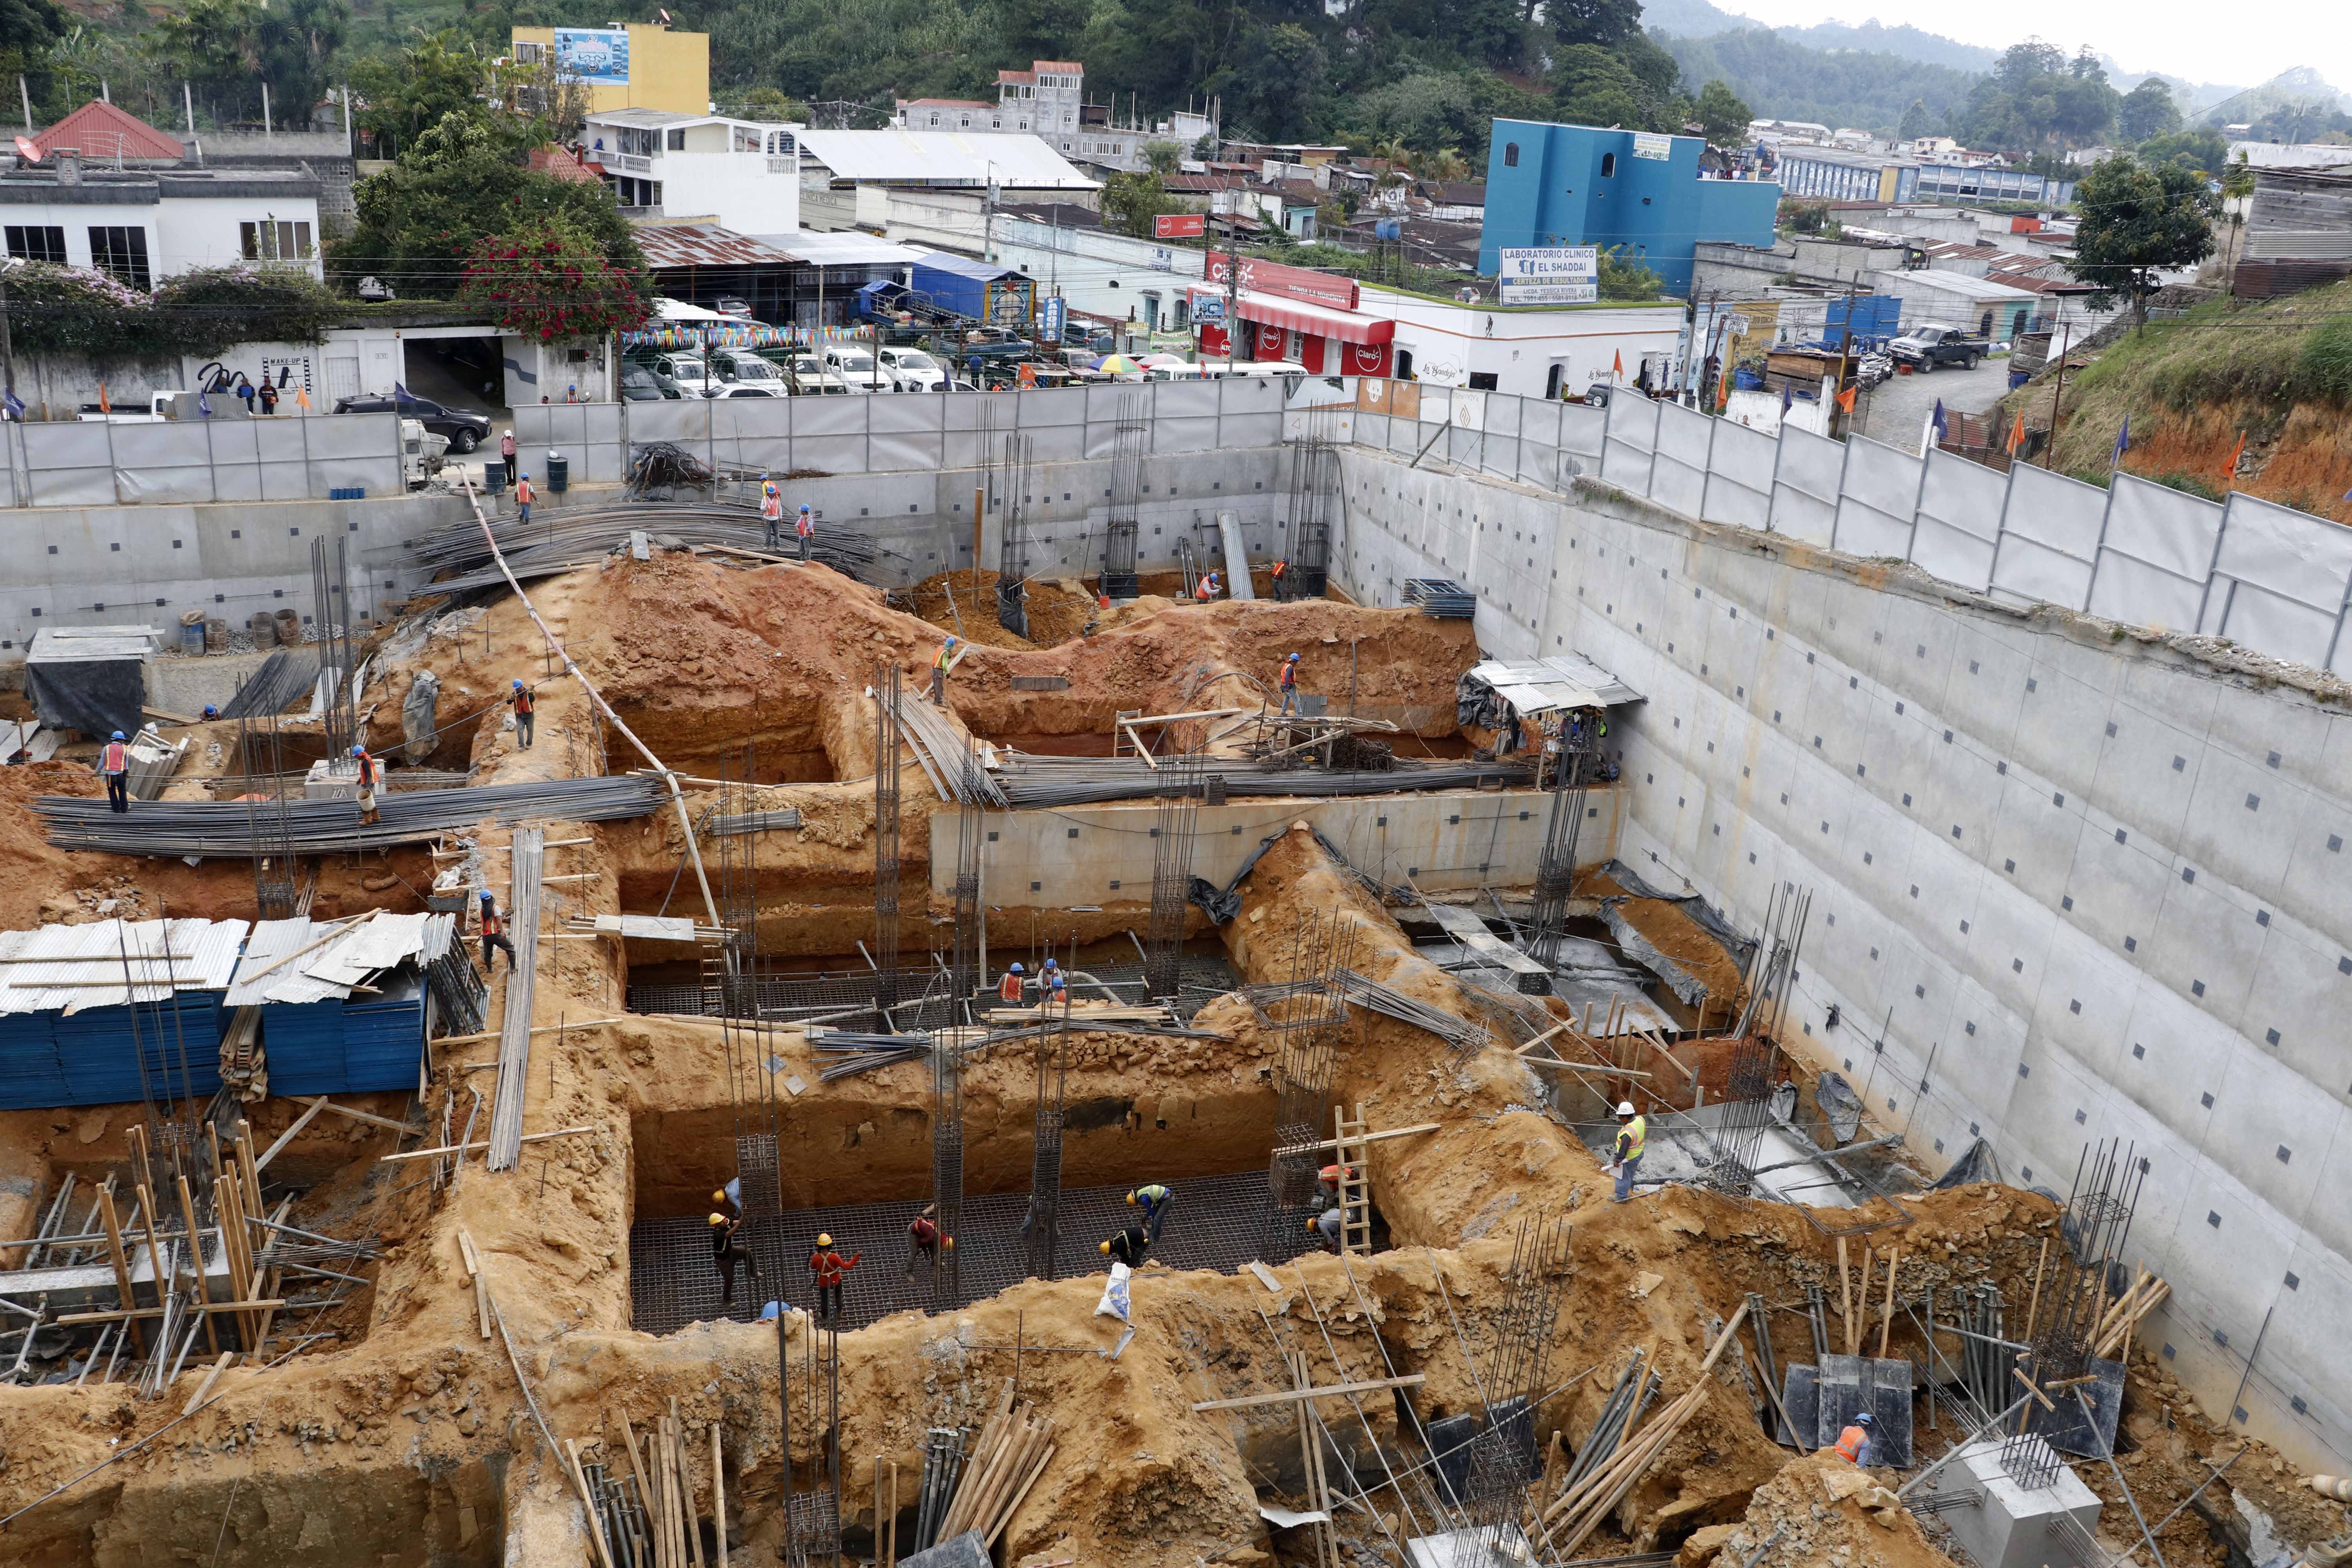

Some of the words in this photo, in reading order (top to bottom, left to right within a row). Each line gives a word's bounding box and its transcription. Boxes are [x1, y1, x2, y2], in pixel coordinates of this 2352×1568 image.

[1809, 167, 1877, 190] apoyando
[800, 192, 818, 202] CLINICA
[819, 194, 837, 205] MEDICA
[1504, 250, 1563, 259] LABORATORIO
[1564, 250, 1594, 258] CLINICO
[1538, 263, 1548, 272] EL
[1552, 263, 1586, 271] SHADDAI
[1289, 285, 1308, 295] TIENDA
[1317, 290, 1345, 303] MORENITA
[1358, 349, 1376, 360] Claro
[1423, 363, 1430, 374] La
[1432, 365, 1455, 379] Bandeja
[1588, 370, 1594, 380] La
